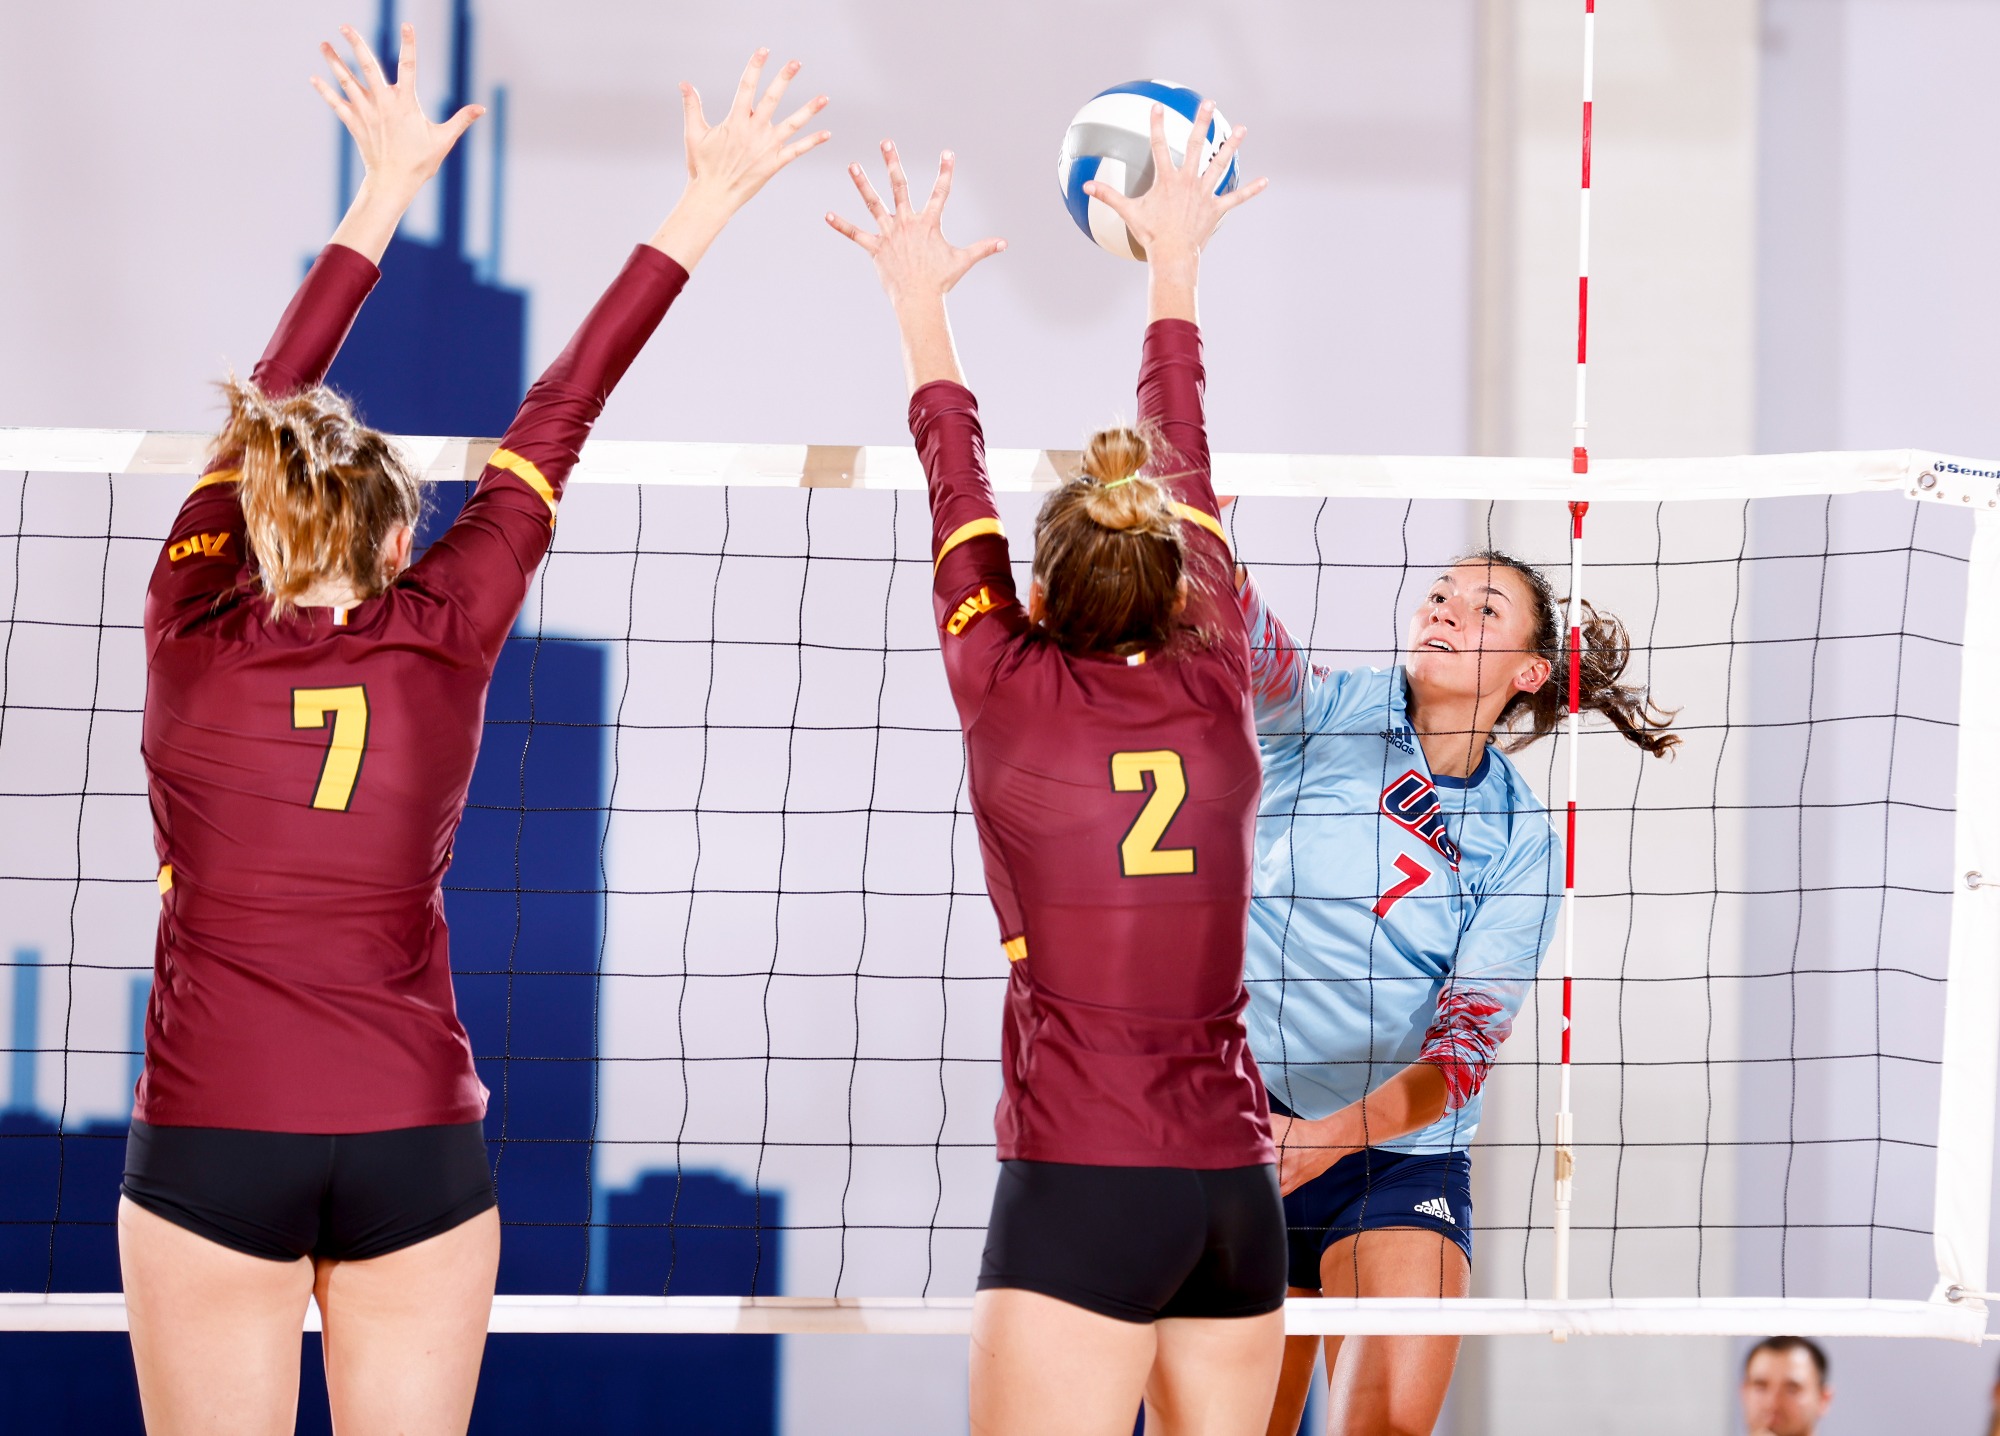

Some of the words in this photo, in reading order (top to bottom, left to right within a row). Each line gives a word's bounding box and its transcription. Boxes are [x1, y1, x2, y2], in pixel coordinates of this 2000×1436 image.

[290, 683, 371, 813] 7
[1379, 731, 1415, 755] adidas
[1108, 748, 1197, 878] 2
[1371, 850, 1434, 920] 7
[1414, 1204, 1456, 1225] adidas
